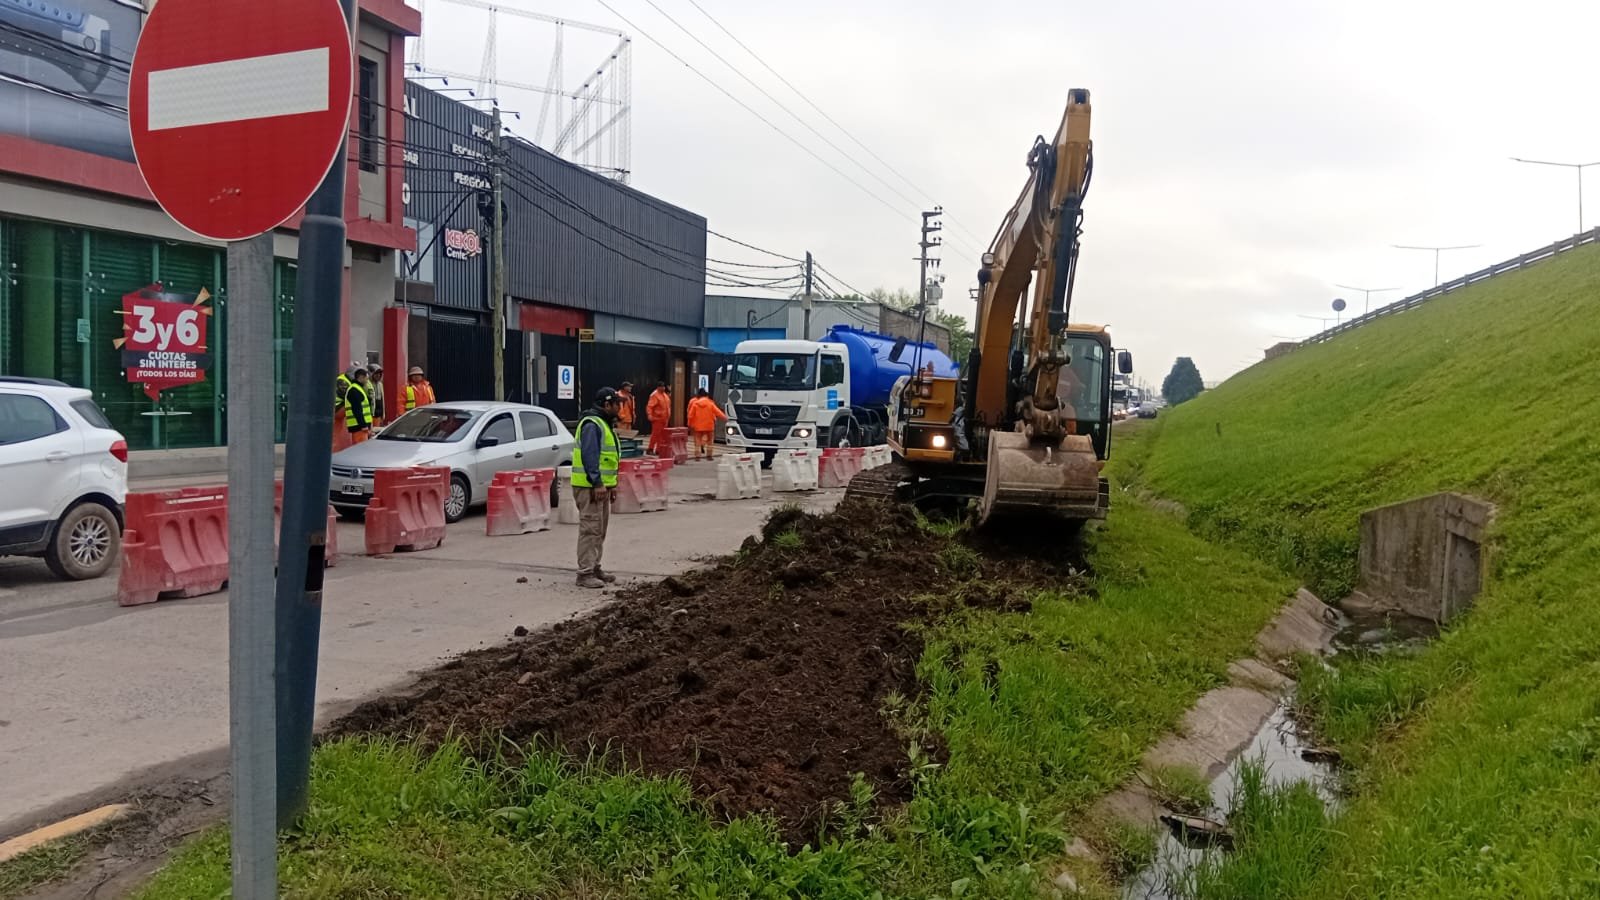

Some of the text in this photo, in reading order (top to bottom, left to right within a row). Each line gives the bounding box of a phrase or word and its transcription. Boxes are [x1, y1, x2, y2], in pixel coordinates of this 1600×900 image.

[445, 228, 482, 254] KEKOL
[148, 351, 186, 360] CUOTAS
[139, 359, 197, 369] SIN INTERES
